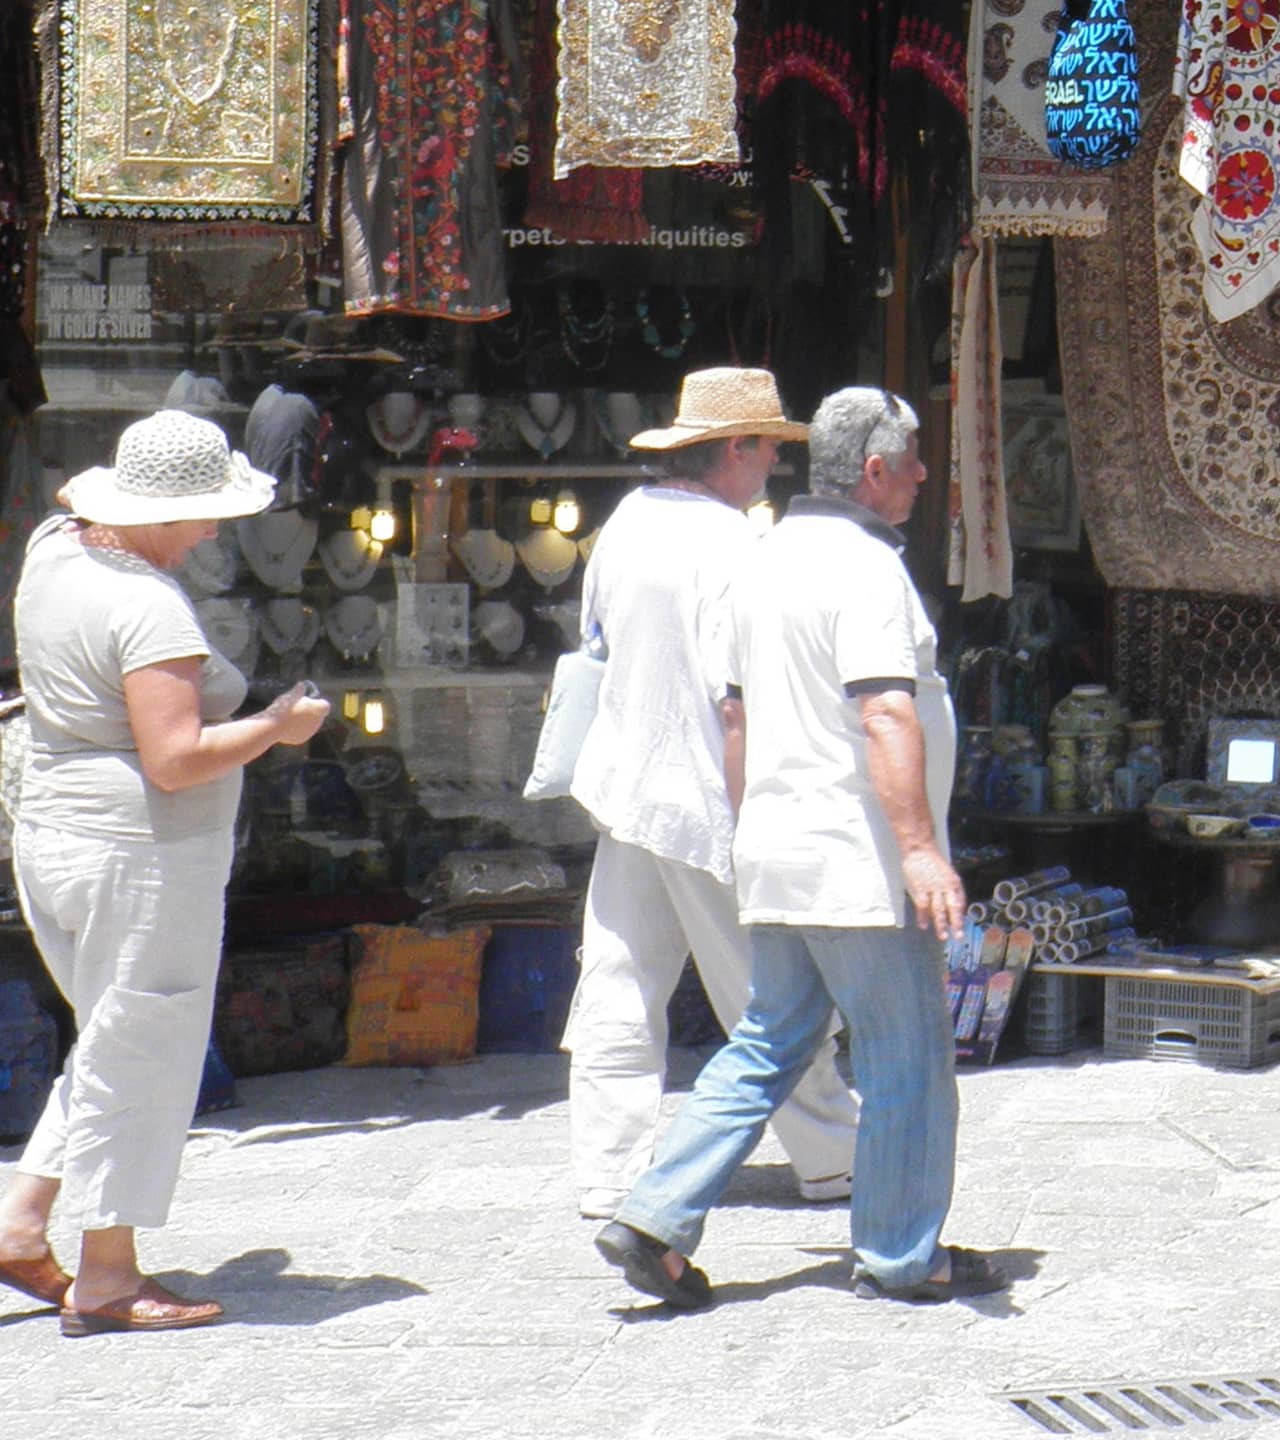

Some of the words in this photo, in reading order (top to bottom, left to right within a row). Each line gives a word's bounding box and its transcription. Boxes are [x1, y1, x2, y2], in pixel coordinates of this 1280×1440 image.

[50, 285, 69, 310] WE
[72, 285, 106, 310] MAKE
[109, 285, 151, 310] NAMES
[48, 313, 61, 338] IN
[64, 313, 96, 338] GOLD
[98, 317, 108, 338] &
[110, 313, 152, 338] SILVER
